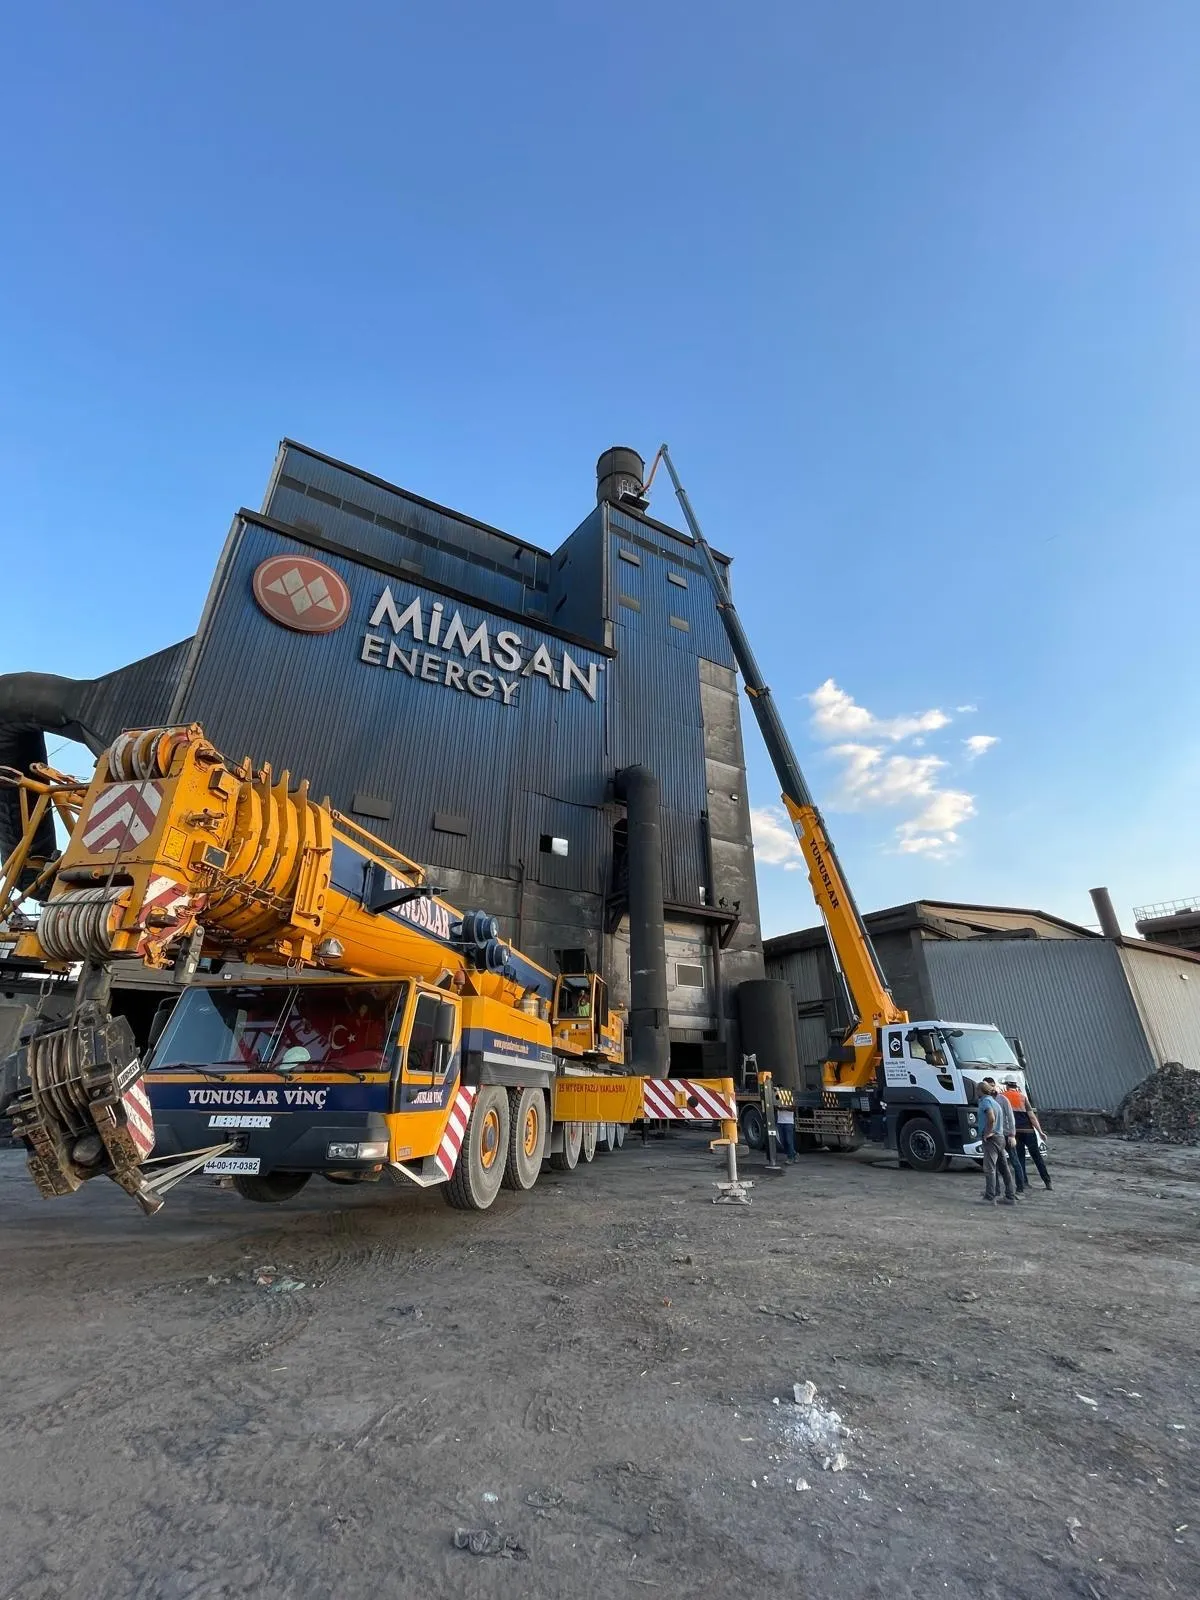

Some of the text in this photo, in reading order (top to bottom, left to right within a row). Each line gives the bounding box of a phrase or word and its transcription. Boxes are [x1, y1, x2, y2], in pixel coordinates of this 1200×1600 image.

[361, 633, 520, 705] ENERGY
[809, 839, 840, 911] YUNUSLAR
[188, 1086, 327, 1109] YUNUSLAR VİNÇ
[207, 1115, 272, 1128] LIEBHERR
